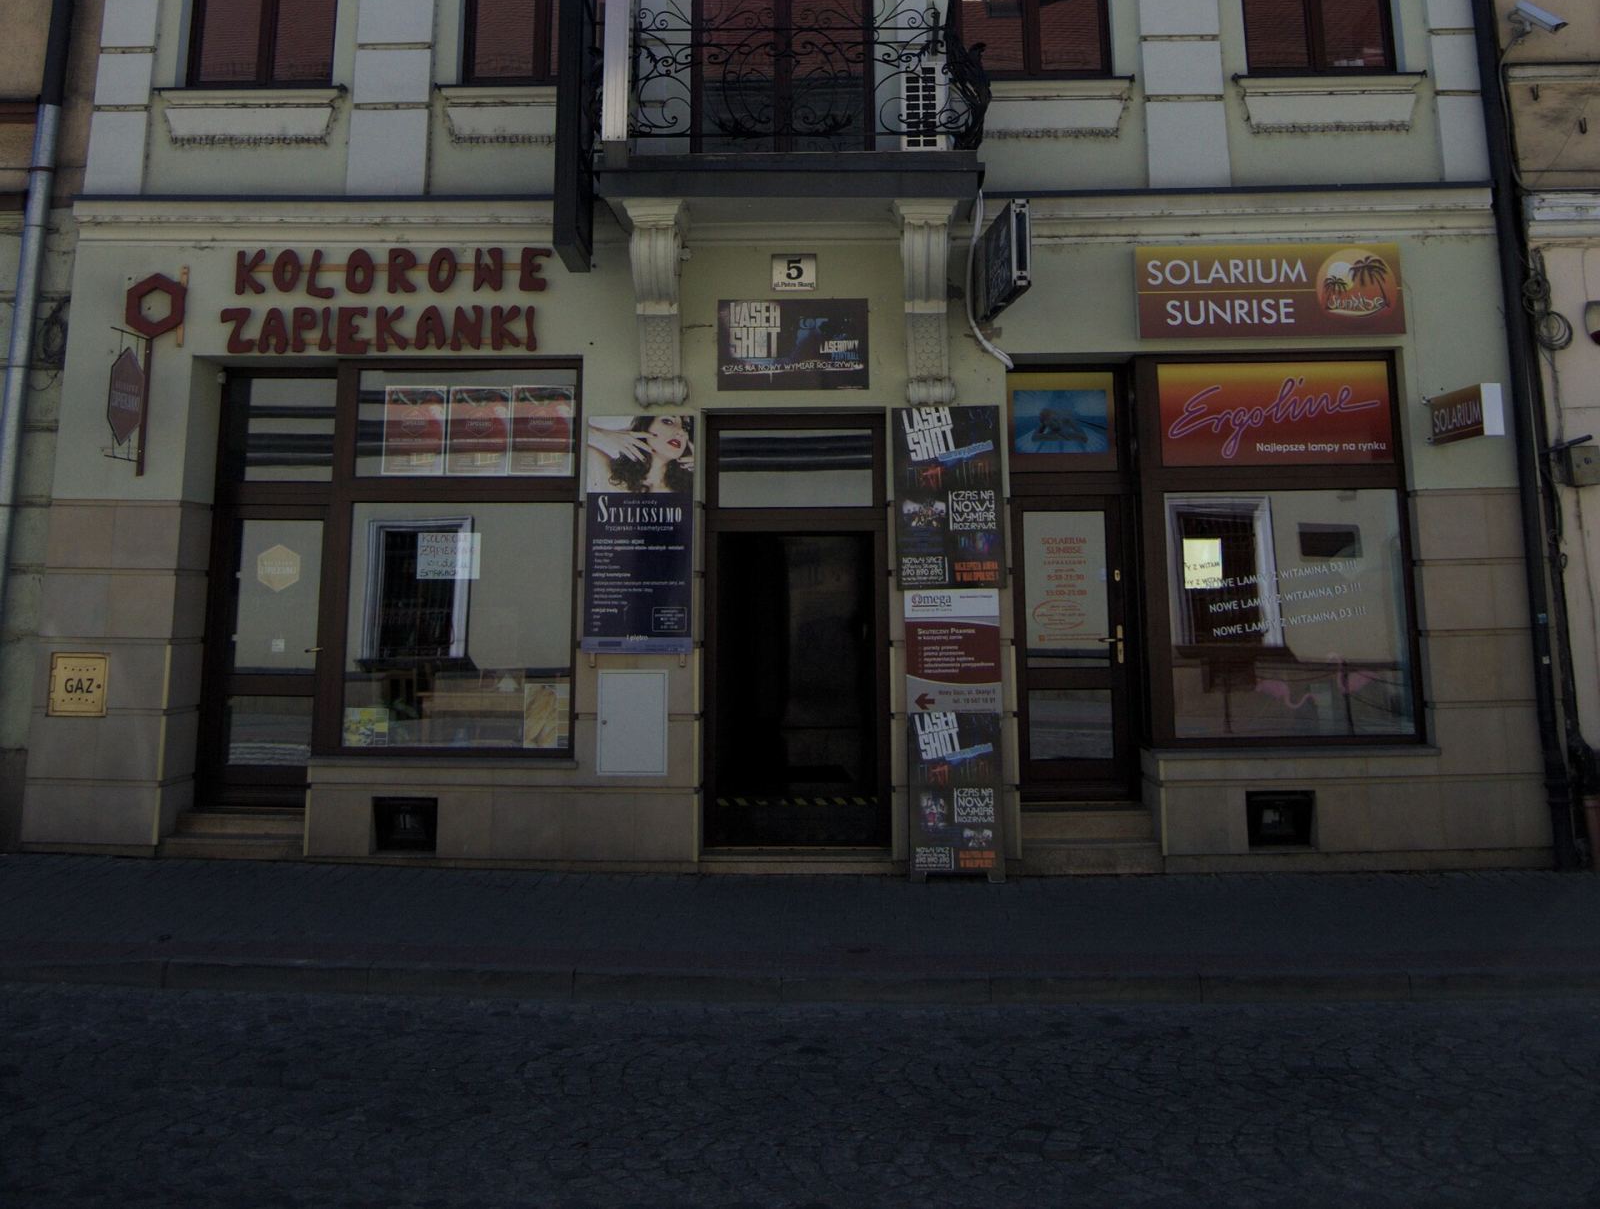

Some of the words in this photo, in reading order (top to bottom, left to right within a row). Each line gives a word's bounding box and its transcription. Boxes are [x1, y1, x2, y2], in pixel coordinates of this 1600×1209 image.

[235, 247, 552, 299] KOLOROWE
[786, 258, 803, 280] 5
[1147, 258, 1308, 286] SOLARIUM
[730, 302, 781, 328] LASER
[1166, 299, 1295, 326] SUNRISE
[220, 305, 537, 354] ZAPIEKANKI
[730, 328, 781, 359] SHOT
[784, 362, 814, 371] WYMIAR
[1168, 376, 1381, 459] Ergoline
[1433, 399, 1481, 433] SOLARIUM
[906, 425, 956, 461] SHOT
[1256, 442, 1306, 453] Najlepsze
[1307, 442, 1339, 452] lampy
[1342, 443, 1356, 451] na
[1358, 441, 1387, 451] rynku
[953, 500, 995, 512] NOWY
[953, 511, 996, 522] WYMIAR
[1330, 562, 1344, 574] D3
[912, 593, 951, 607] Omega
[1209, 599, 1239, 613] NOWE
[1334, 585, 1347, 596] D3
[1213, 624, 1243, 638] NOWE
[1339, 608, 1352, 619] D3
[64, 678, 94, 694] GAZ
[919, 728, 961, 760] SHOT
[958, 797, 994, 807] NOWY
